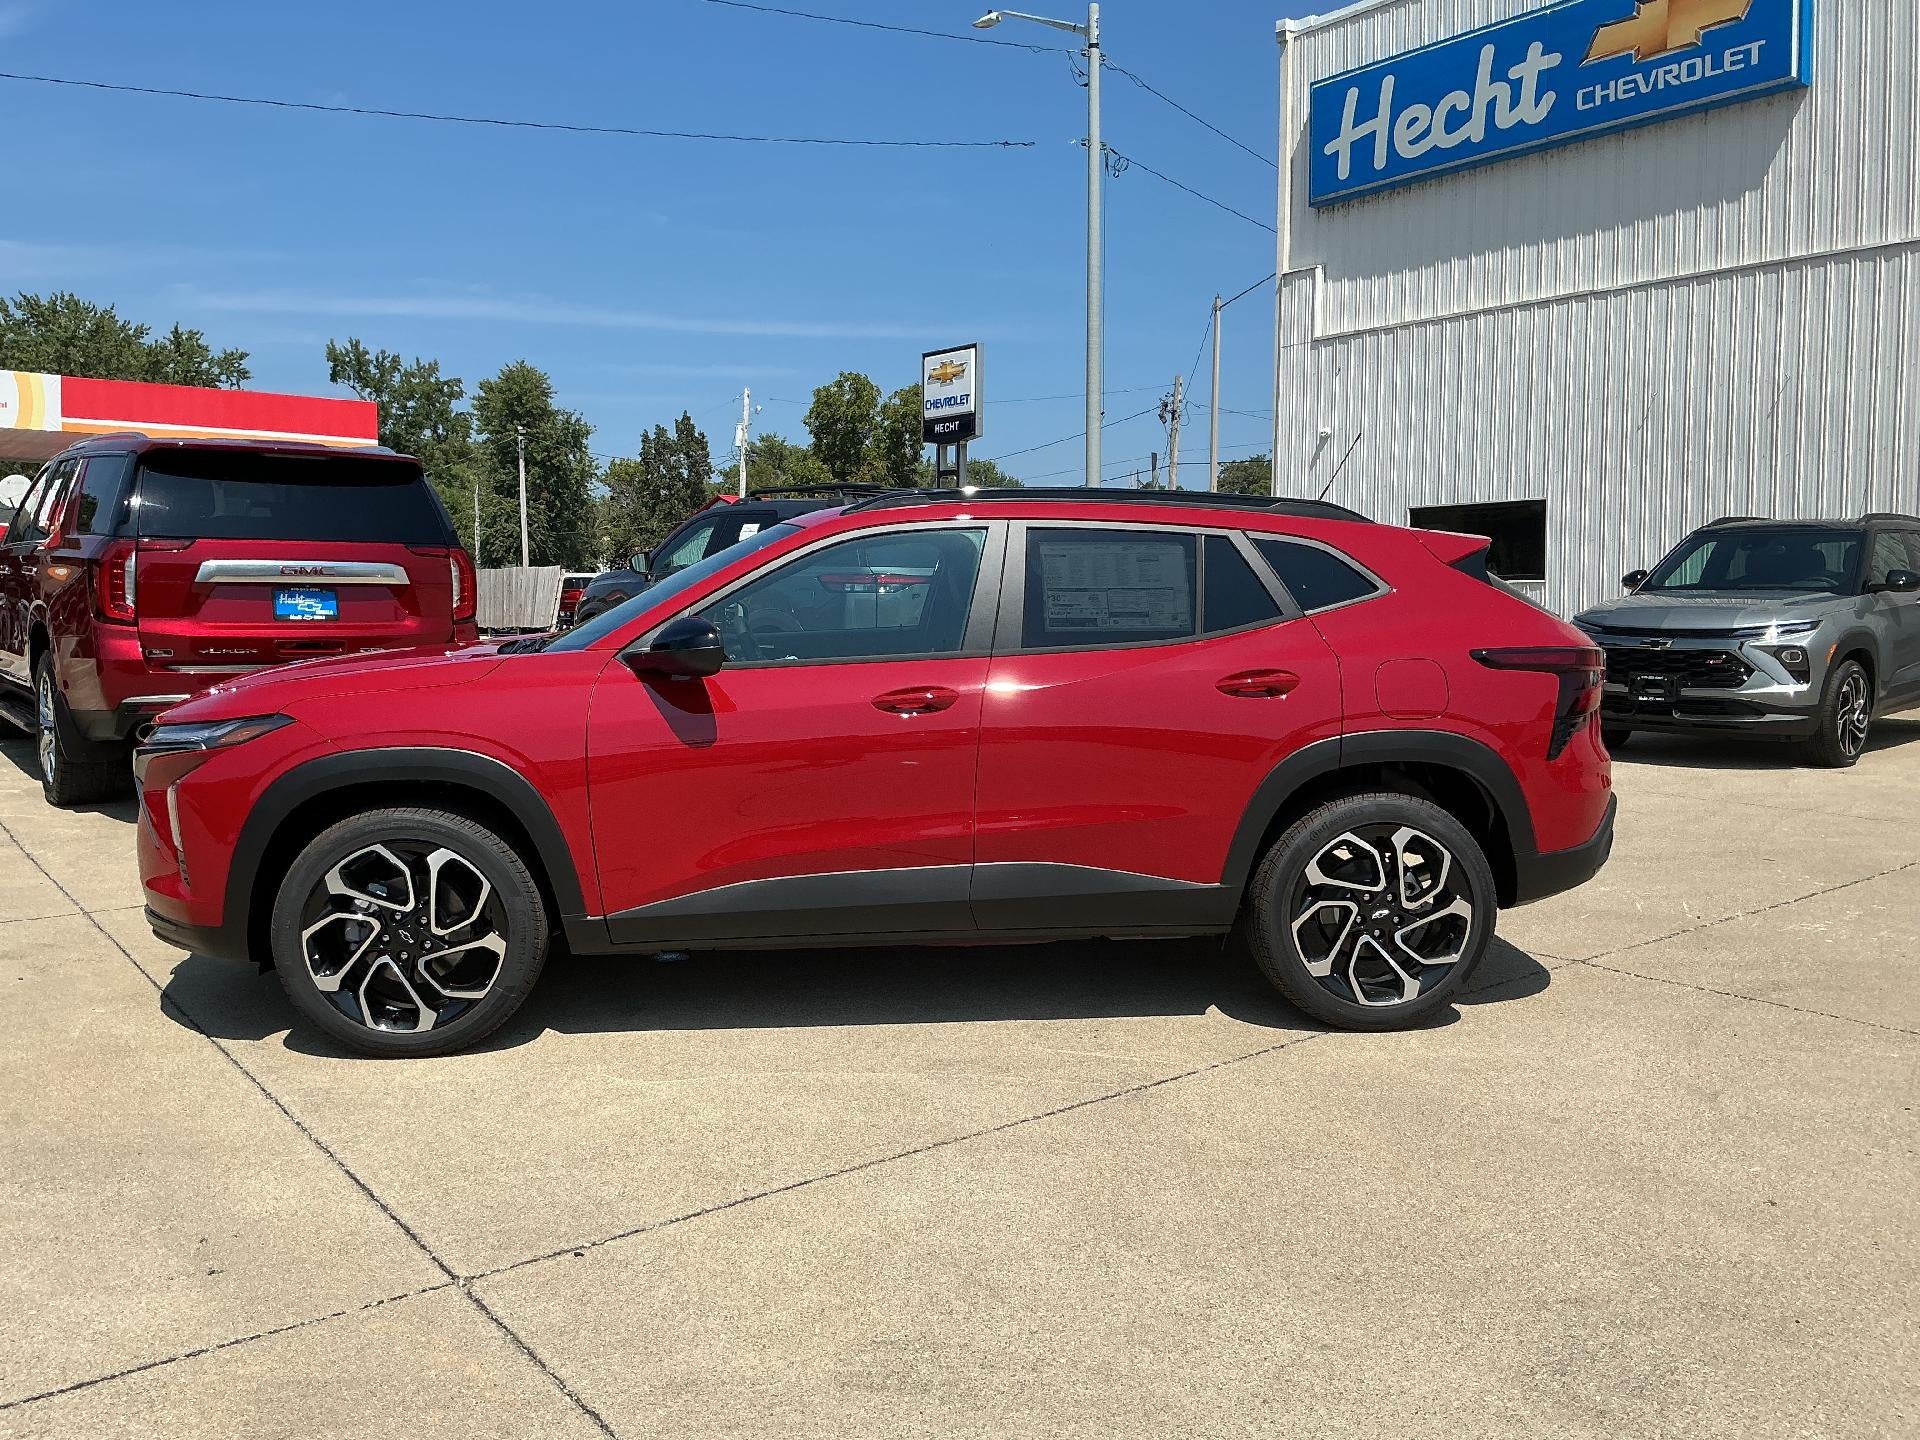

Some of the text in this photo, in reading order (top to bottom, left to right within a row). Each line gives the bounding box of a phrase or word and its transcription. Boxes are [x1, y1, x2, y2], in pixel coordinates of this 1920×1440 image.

[1576, 39, 1766, 111] CHEVROLET
[1323, 41, 1563, 181] Hecht
[925, 393, 970, 410] CHEVROLET
[934, 420, 960, 434] HECHT
[280, 566, 336, 577] GMC
